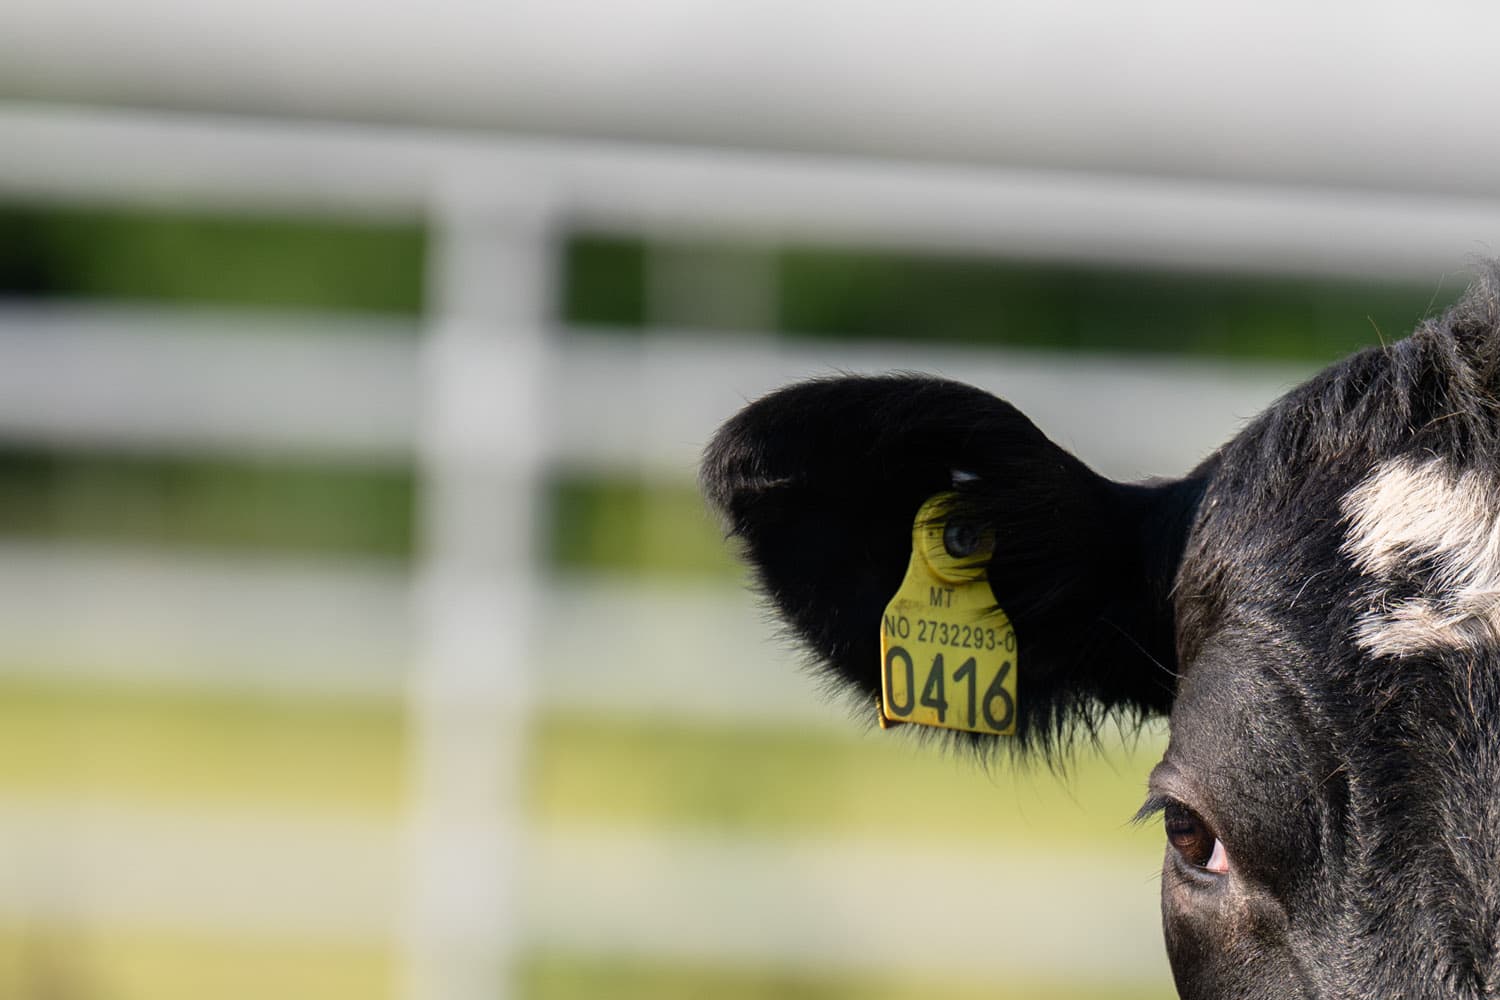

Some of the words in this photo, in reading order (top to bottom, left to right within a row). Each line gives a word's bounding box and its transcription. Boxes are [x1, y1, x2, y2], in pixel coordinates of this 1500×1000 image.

[929, 586, 955, 608] MT
[884, 614, 910, 639] NO
[918, 620, 1015, 653] 2732293-0
[885, 646, 1015, 731] 0416
